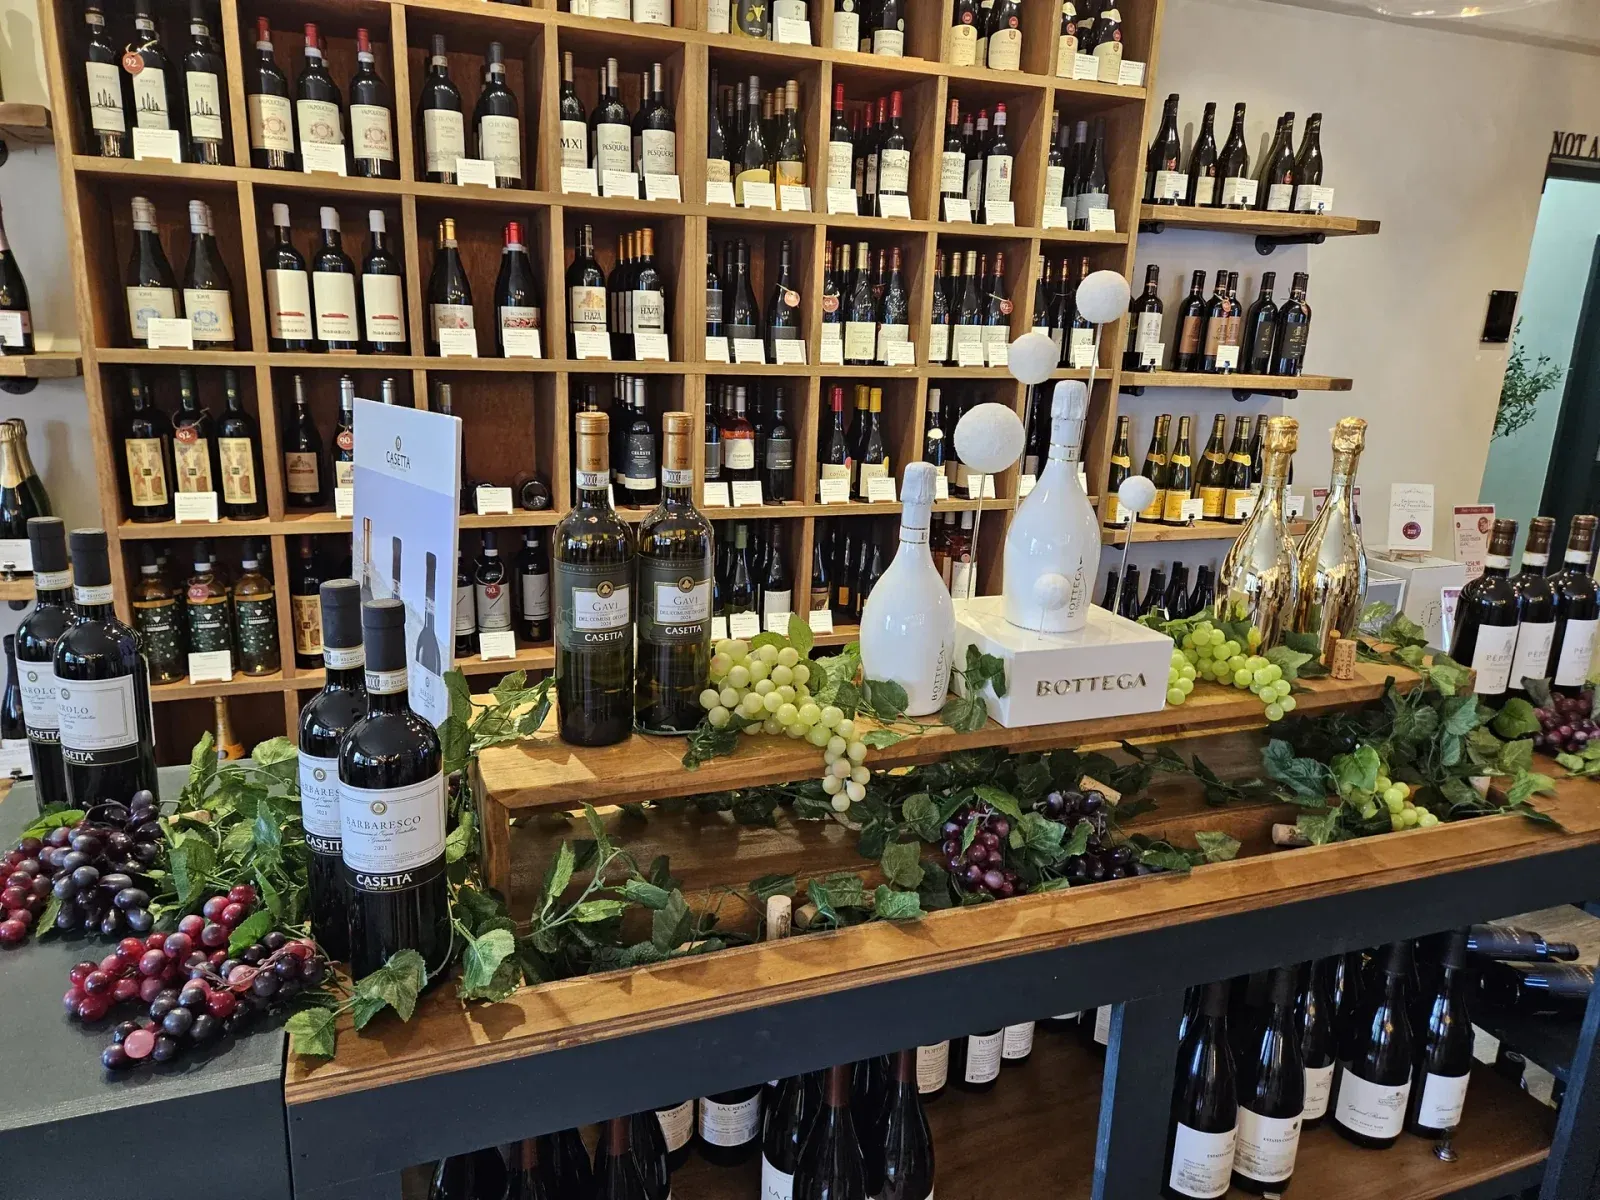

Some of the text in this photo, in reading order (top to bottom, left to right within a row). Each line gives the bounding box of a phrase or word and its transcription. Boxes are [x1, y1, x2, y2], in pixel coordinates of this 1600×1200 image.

[126, 56, 137, 67] 92
[1550, 130, 1587, 157] NOT
[583, 311, 602, 321] HAZA
[640, 307, 660, 315] HAZA
[178, 430, 191, 441] 92
[339, 436, 351, 445] 90
[386, 450, 411, 469] CASETTA
[486, 586, 496, 594] 90
[1066, 565, 1084, 619] BOTTEGA
[592, 601, 619, 612] GAVI
[674, 596, 699, 606] GAVI
[664, 624, 702, 635] CASETTA
[584, 630, 624, 642] CASETTA
[930, 647, 945, 702] BOTTEGA
[1036, 672, 1148, 699] BOTTEGA
[26, 727, 61, 740] CASETTA
[61, 748, 95, 762] ASETTA
[346, 815, 421, 830] BARBARESCO
[305, 834, 343, 851] CASETT
[356, 873, 410, 887] CASETTA
[717, 1102, 752, 1114] LA CREMA
